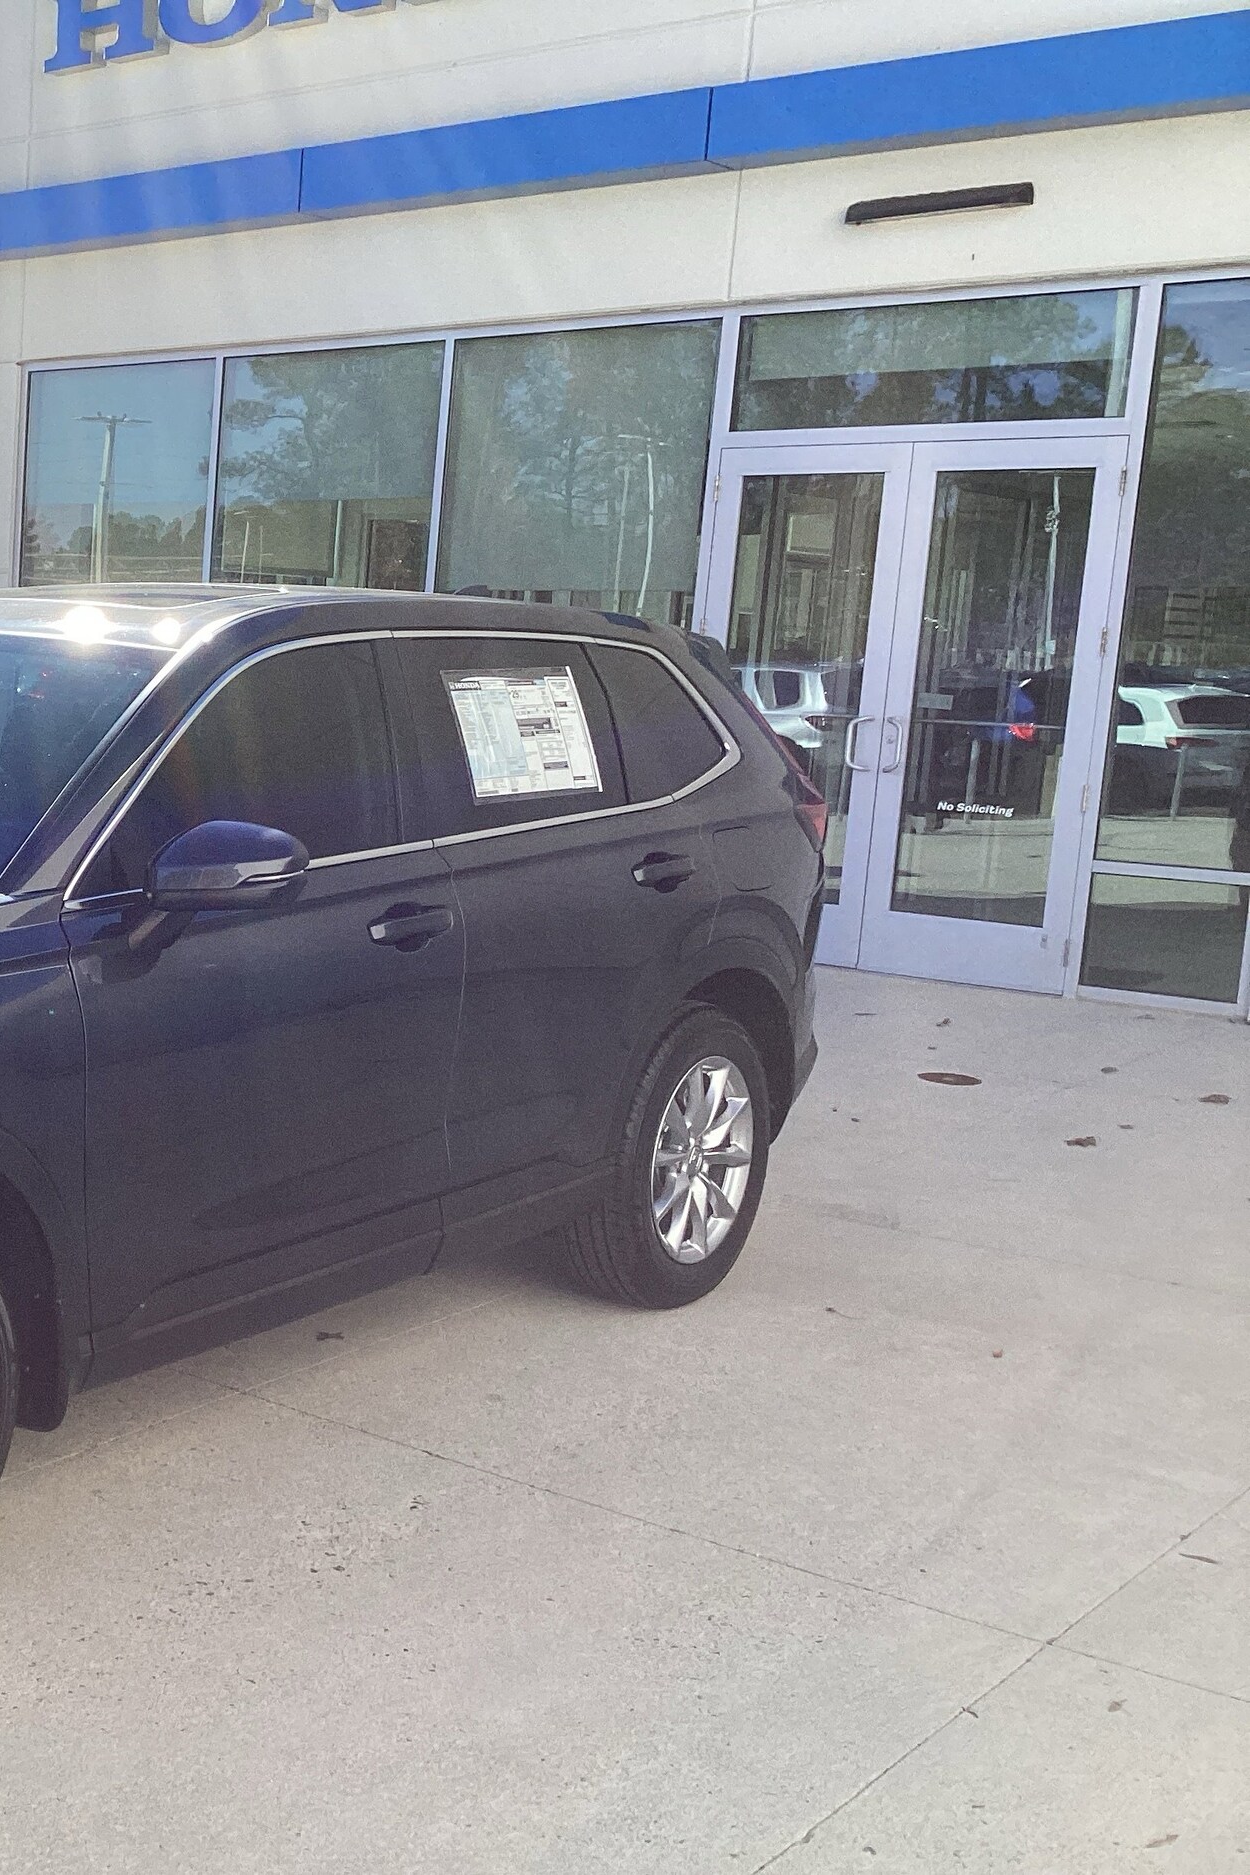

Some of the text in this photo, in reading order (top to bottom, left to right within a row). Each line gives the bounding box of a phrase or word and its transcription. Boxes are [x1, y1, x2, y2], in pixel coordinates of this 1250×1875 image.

[454, 682, 480, 690] HONDA
[937, 801, 1014, 817] No Soliciting
